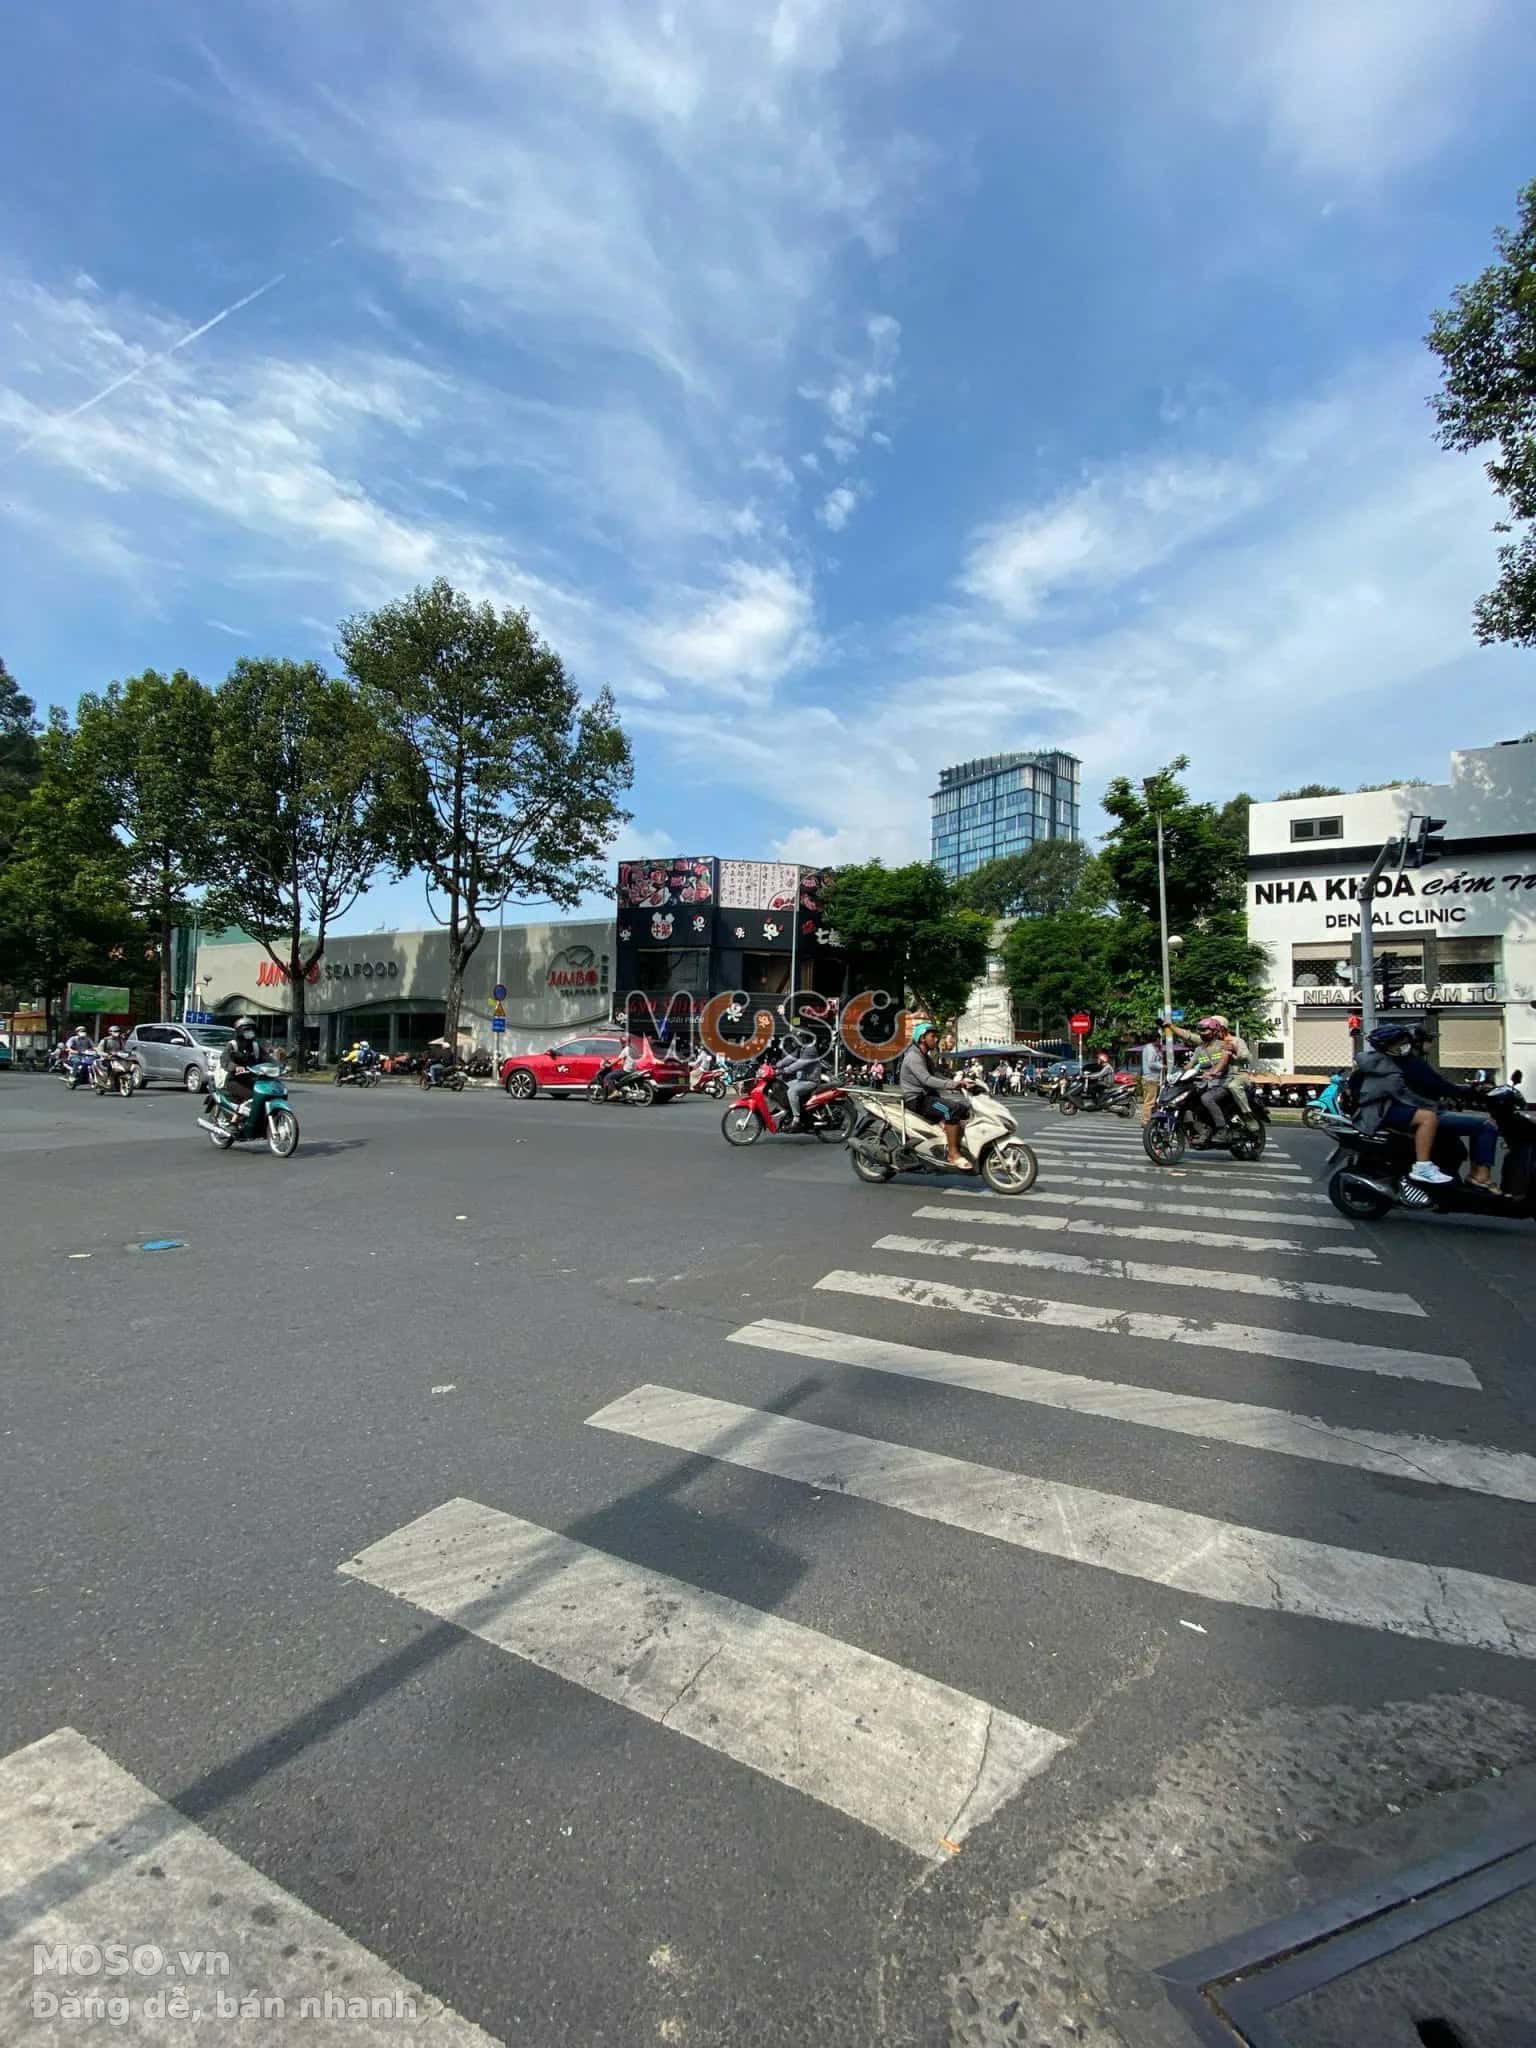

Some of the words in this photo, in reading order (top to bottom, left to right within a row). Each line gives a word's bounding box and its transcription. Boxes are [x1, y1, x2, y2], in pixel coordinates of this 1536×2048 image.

[1255, 880, 1317, 905] NHA
[1326, 911, 1393, 929] DENAL
[1399, 907, 1466, 925] CLINIC
[256, 960, 321, 986] JUMO
[325, 961, 399, 981] SEAFOOD
[1303, 988, 1346, 1005] NHA
